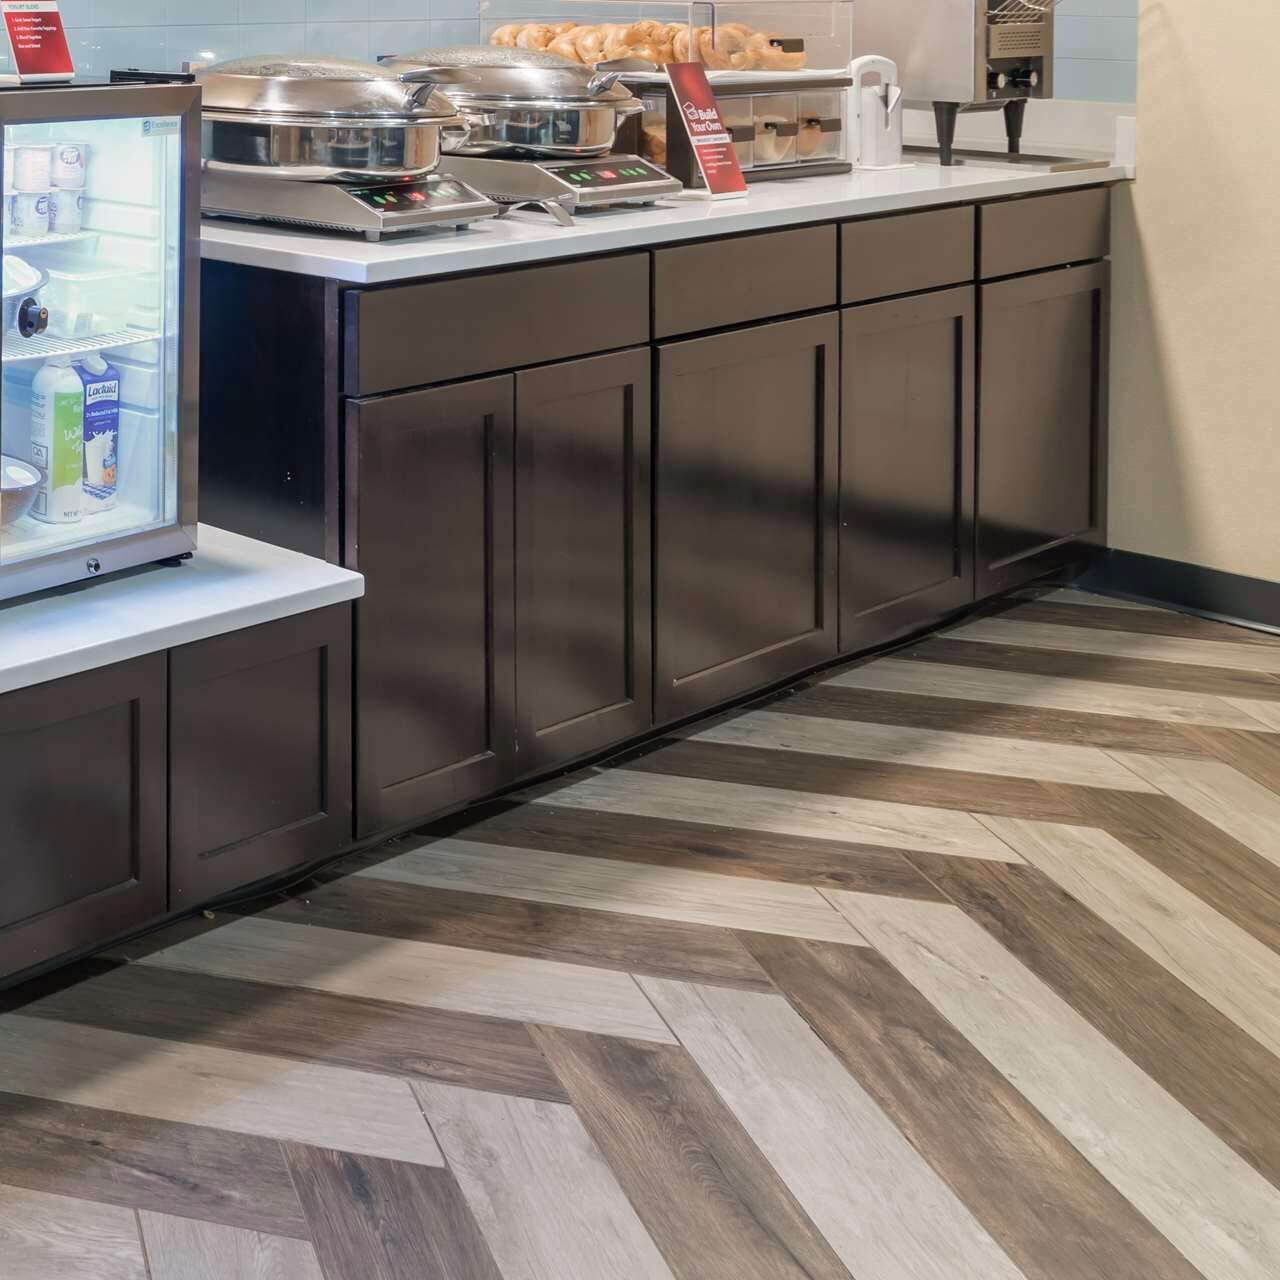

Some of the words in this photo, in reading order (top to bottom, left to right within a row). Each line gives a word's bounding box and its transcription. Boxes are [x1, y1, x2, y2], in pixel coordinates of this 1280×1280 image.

[698, 108, 718, 120] Build
[690, 121, 706, 132] Your
[705, 121, 722, 131] Own
[88, 382, 117, 398] Lactaid
